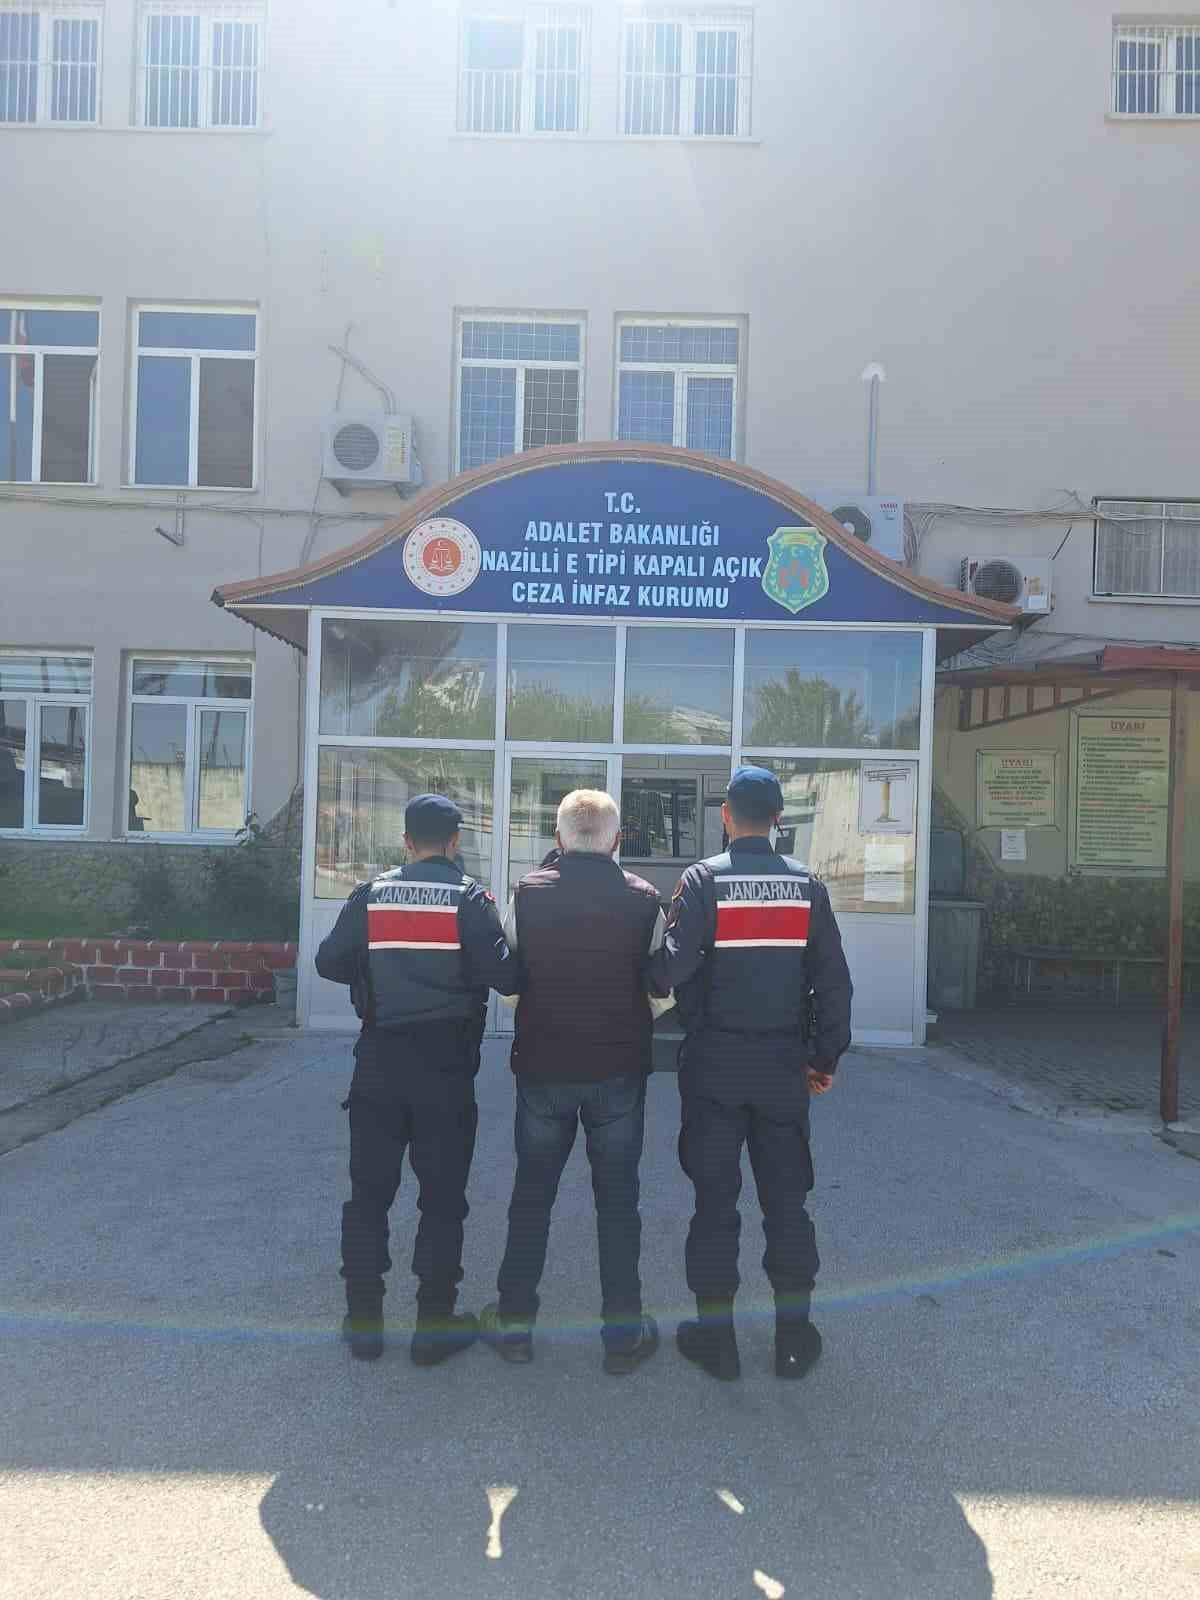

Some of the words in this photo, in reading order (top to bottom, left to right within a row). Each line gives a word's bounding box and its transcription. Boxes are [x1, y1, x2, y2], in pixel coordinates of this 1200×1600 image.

[605, 492, 641, 513] T.C.
[524, 521, 603, 545] ADALET
[609, 521, 719, 545] BAKANLIĞI
[481, 548, 559, 573] NAZİLLİ
[566, 553, 578, 574] E
[586, 549, 627, 576] TİPİ
[634, 554, 705, 578] KAPALI
[712, 556, 763, 583] AÇIK
[512, 582, 565, 605] CEZA
[572, 580, 630, 607] İNFAZ
[637, 585, 730, 609] KURUMU
[376, 886, 451, 906] JANDARMA
[725, 881, 803, 901] JANDARMA
